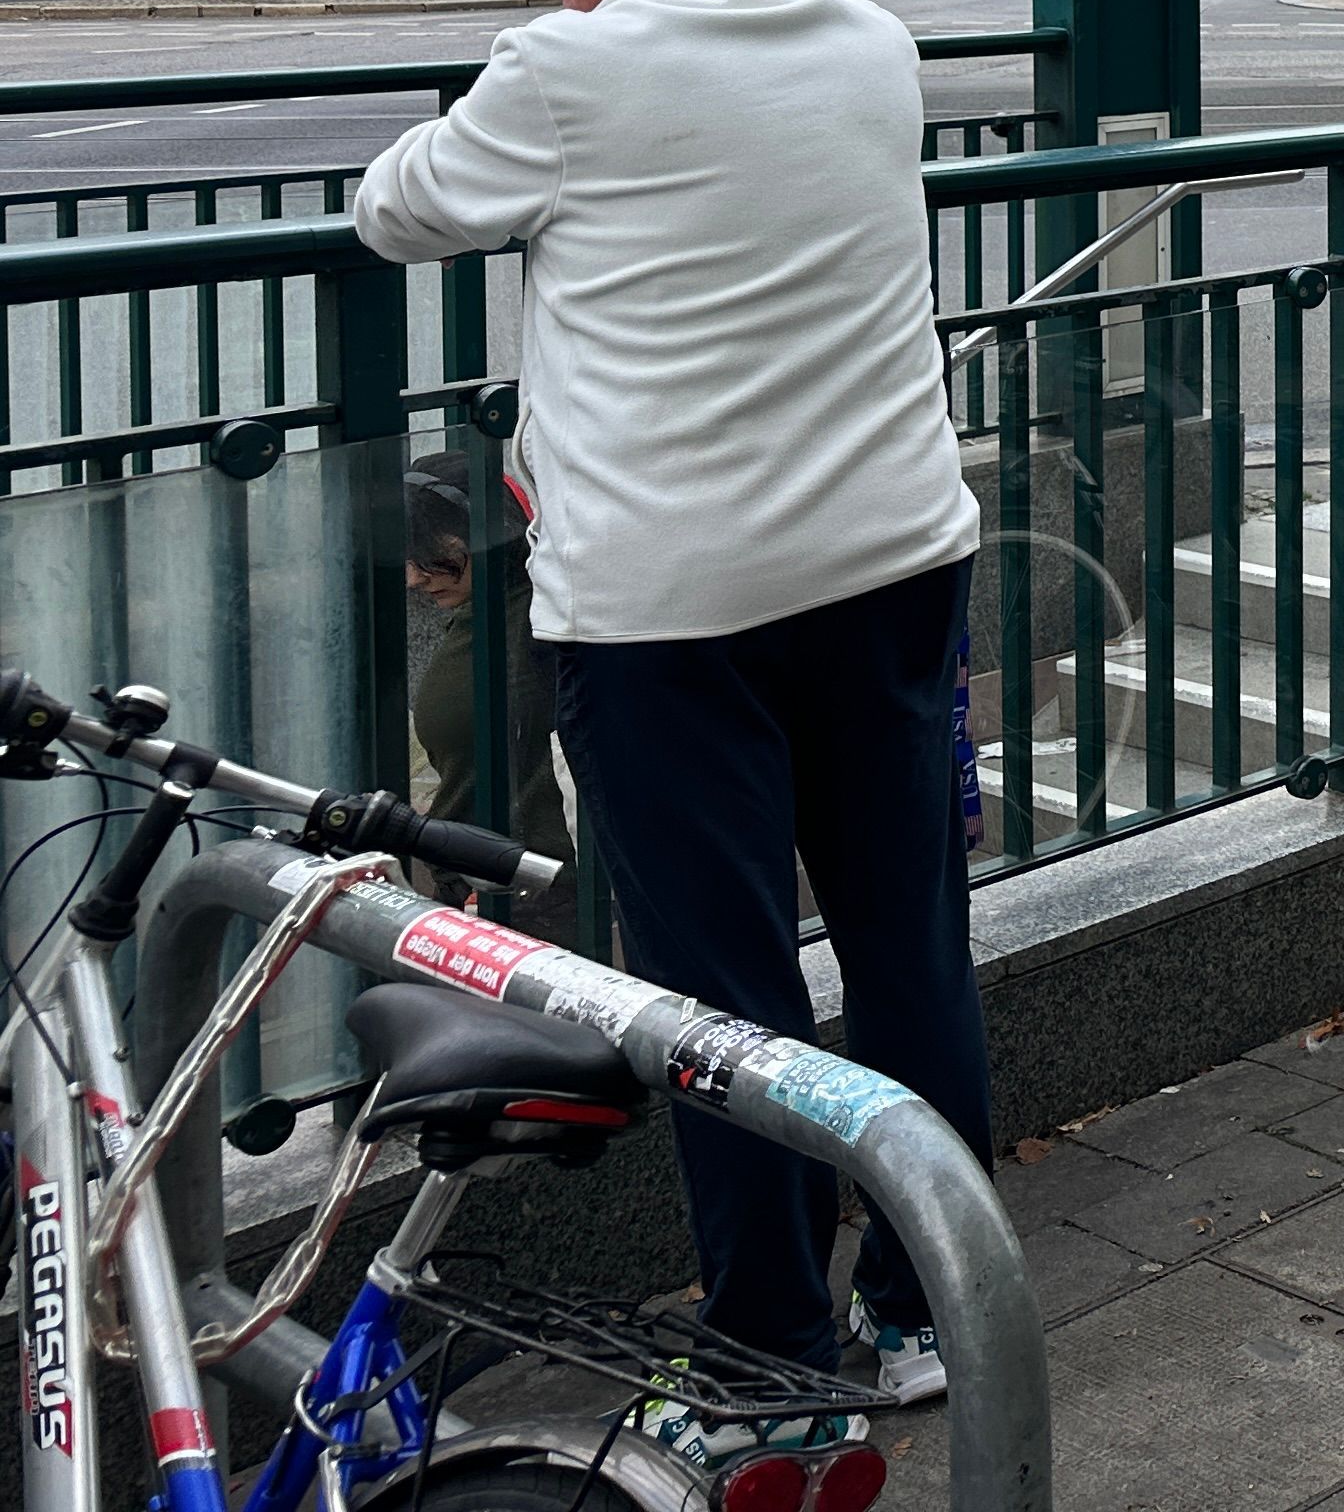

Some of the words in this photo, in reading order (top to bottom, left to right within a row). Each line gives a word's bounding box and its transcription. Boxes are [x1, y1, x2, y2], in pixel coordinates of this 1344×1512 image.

[963, 758, 979, 800] USA
[472, 964, 500, 990] Von
[29, 1180, 69, 1451] PEGASUS
